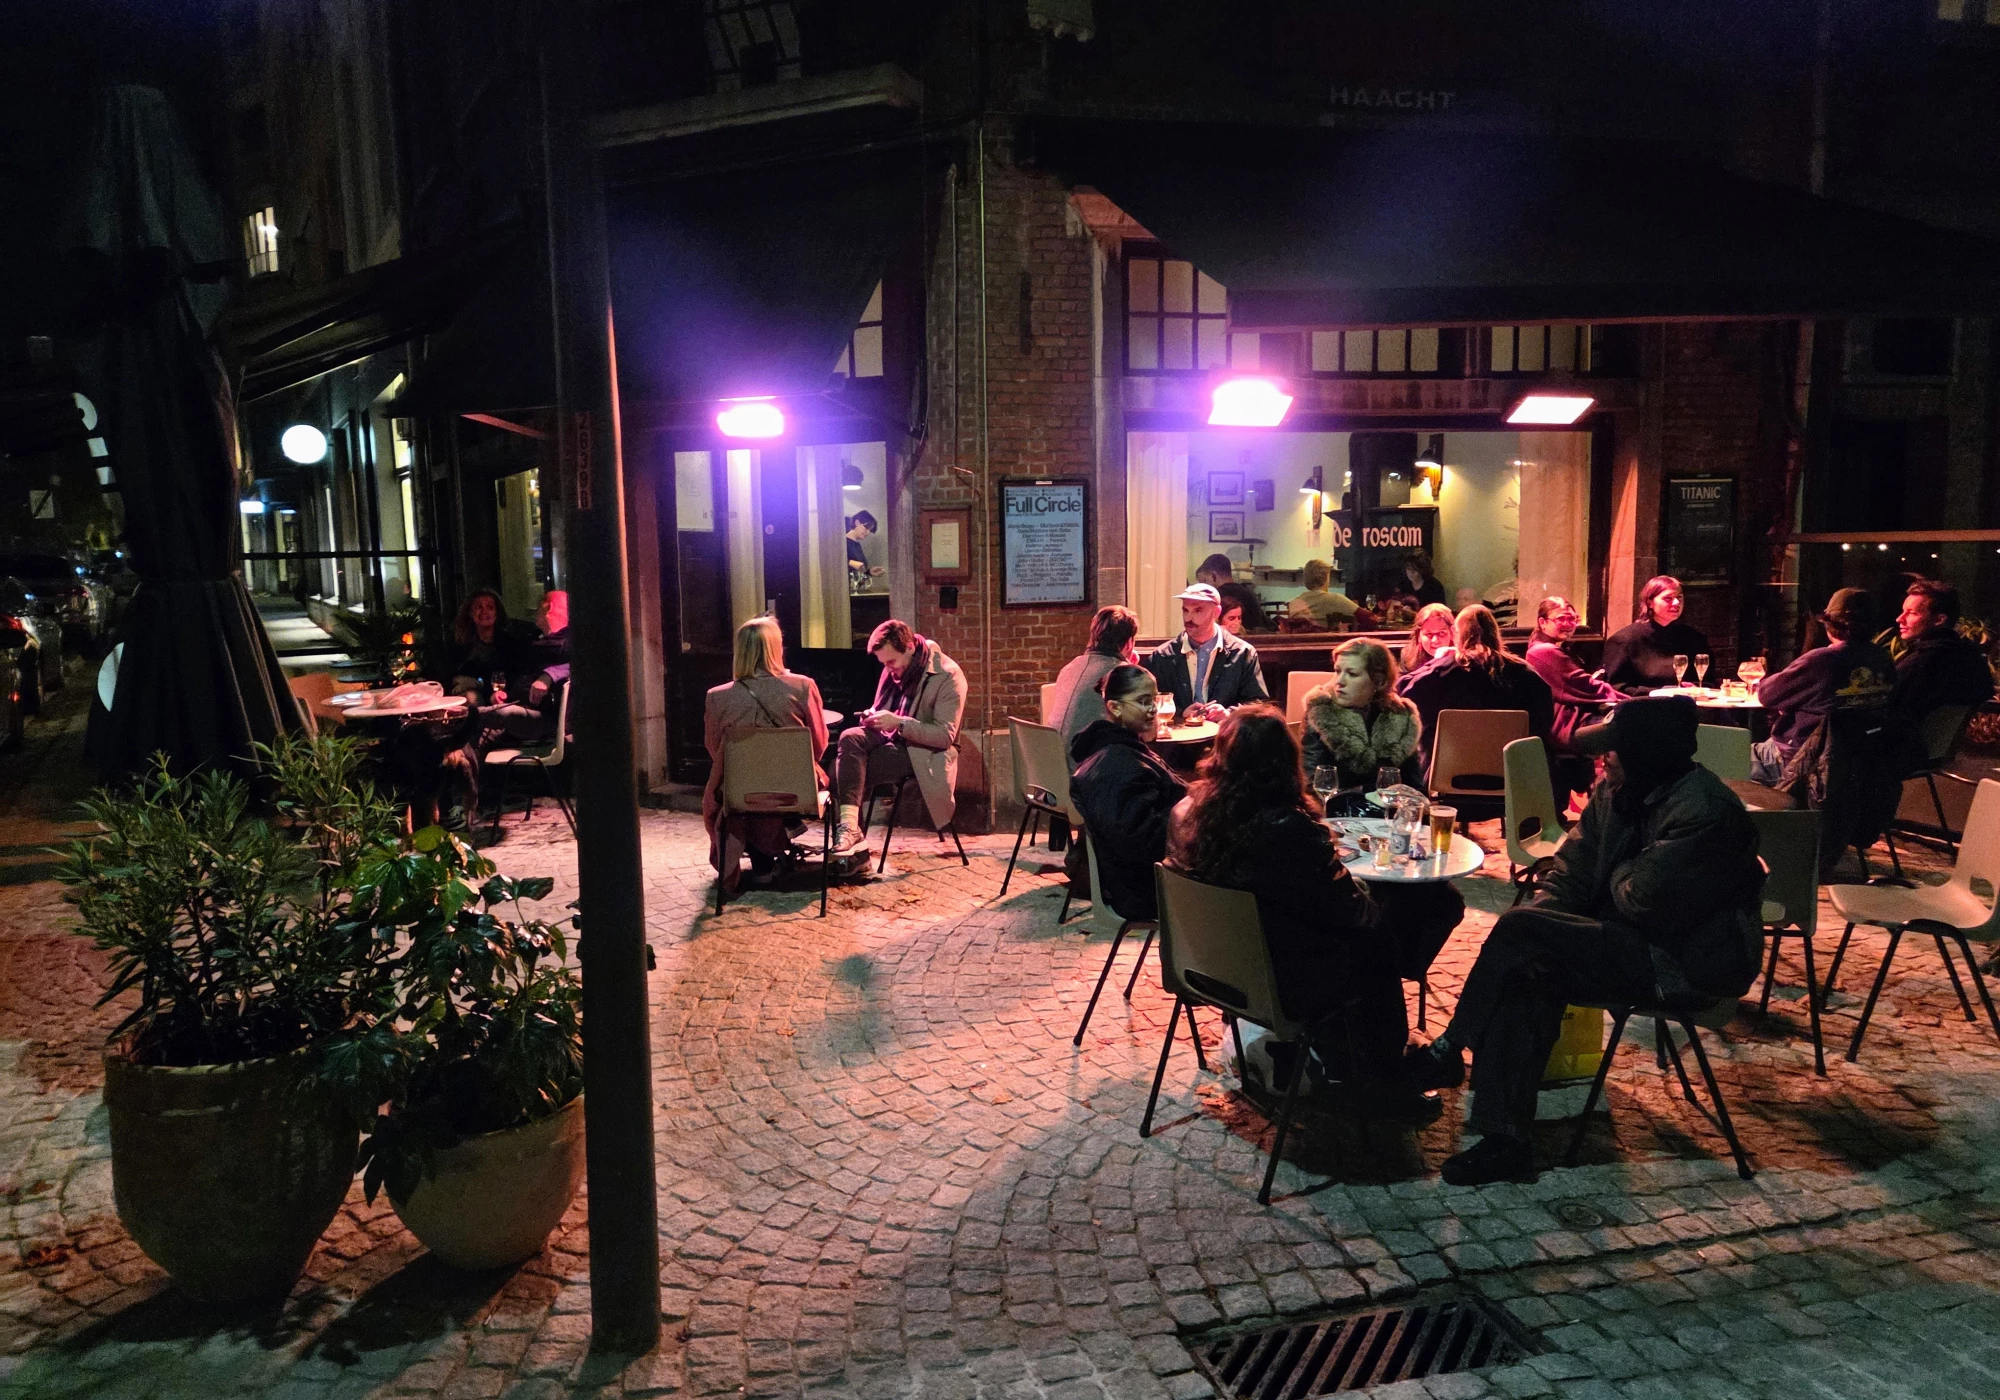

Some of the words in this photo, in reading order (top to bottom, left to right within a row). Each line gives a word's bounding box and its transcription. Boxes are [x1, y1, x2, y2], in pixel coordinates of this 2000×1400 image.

[1330, 85, 1456, 109] HAACHT
[1681, 487, 1721, 500] TITANIC
[1006, 497, 1032, 512] Full
[1035, 496, 1081, 513] Circle
[1334, 519, 1352, 548] de
[1362, 526, 1422, 547] roscam
